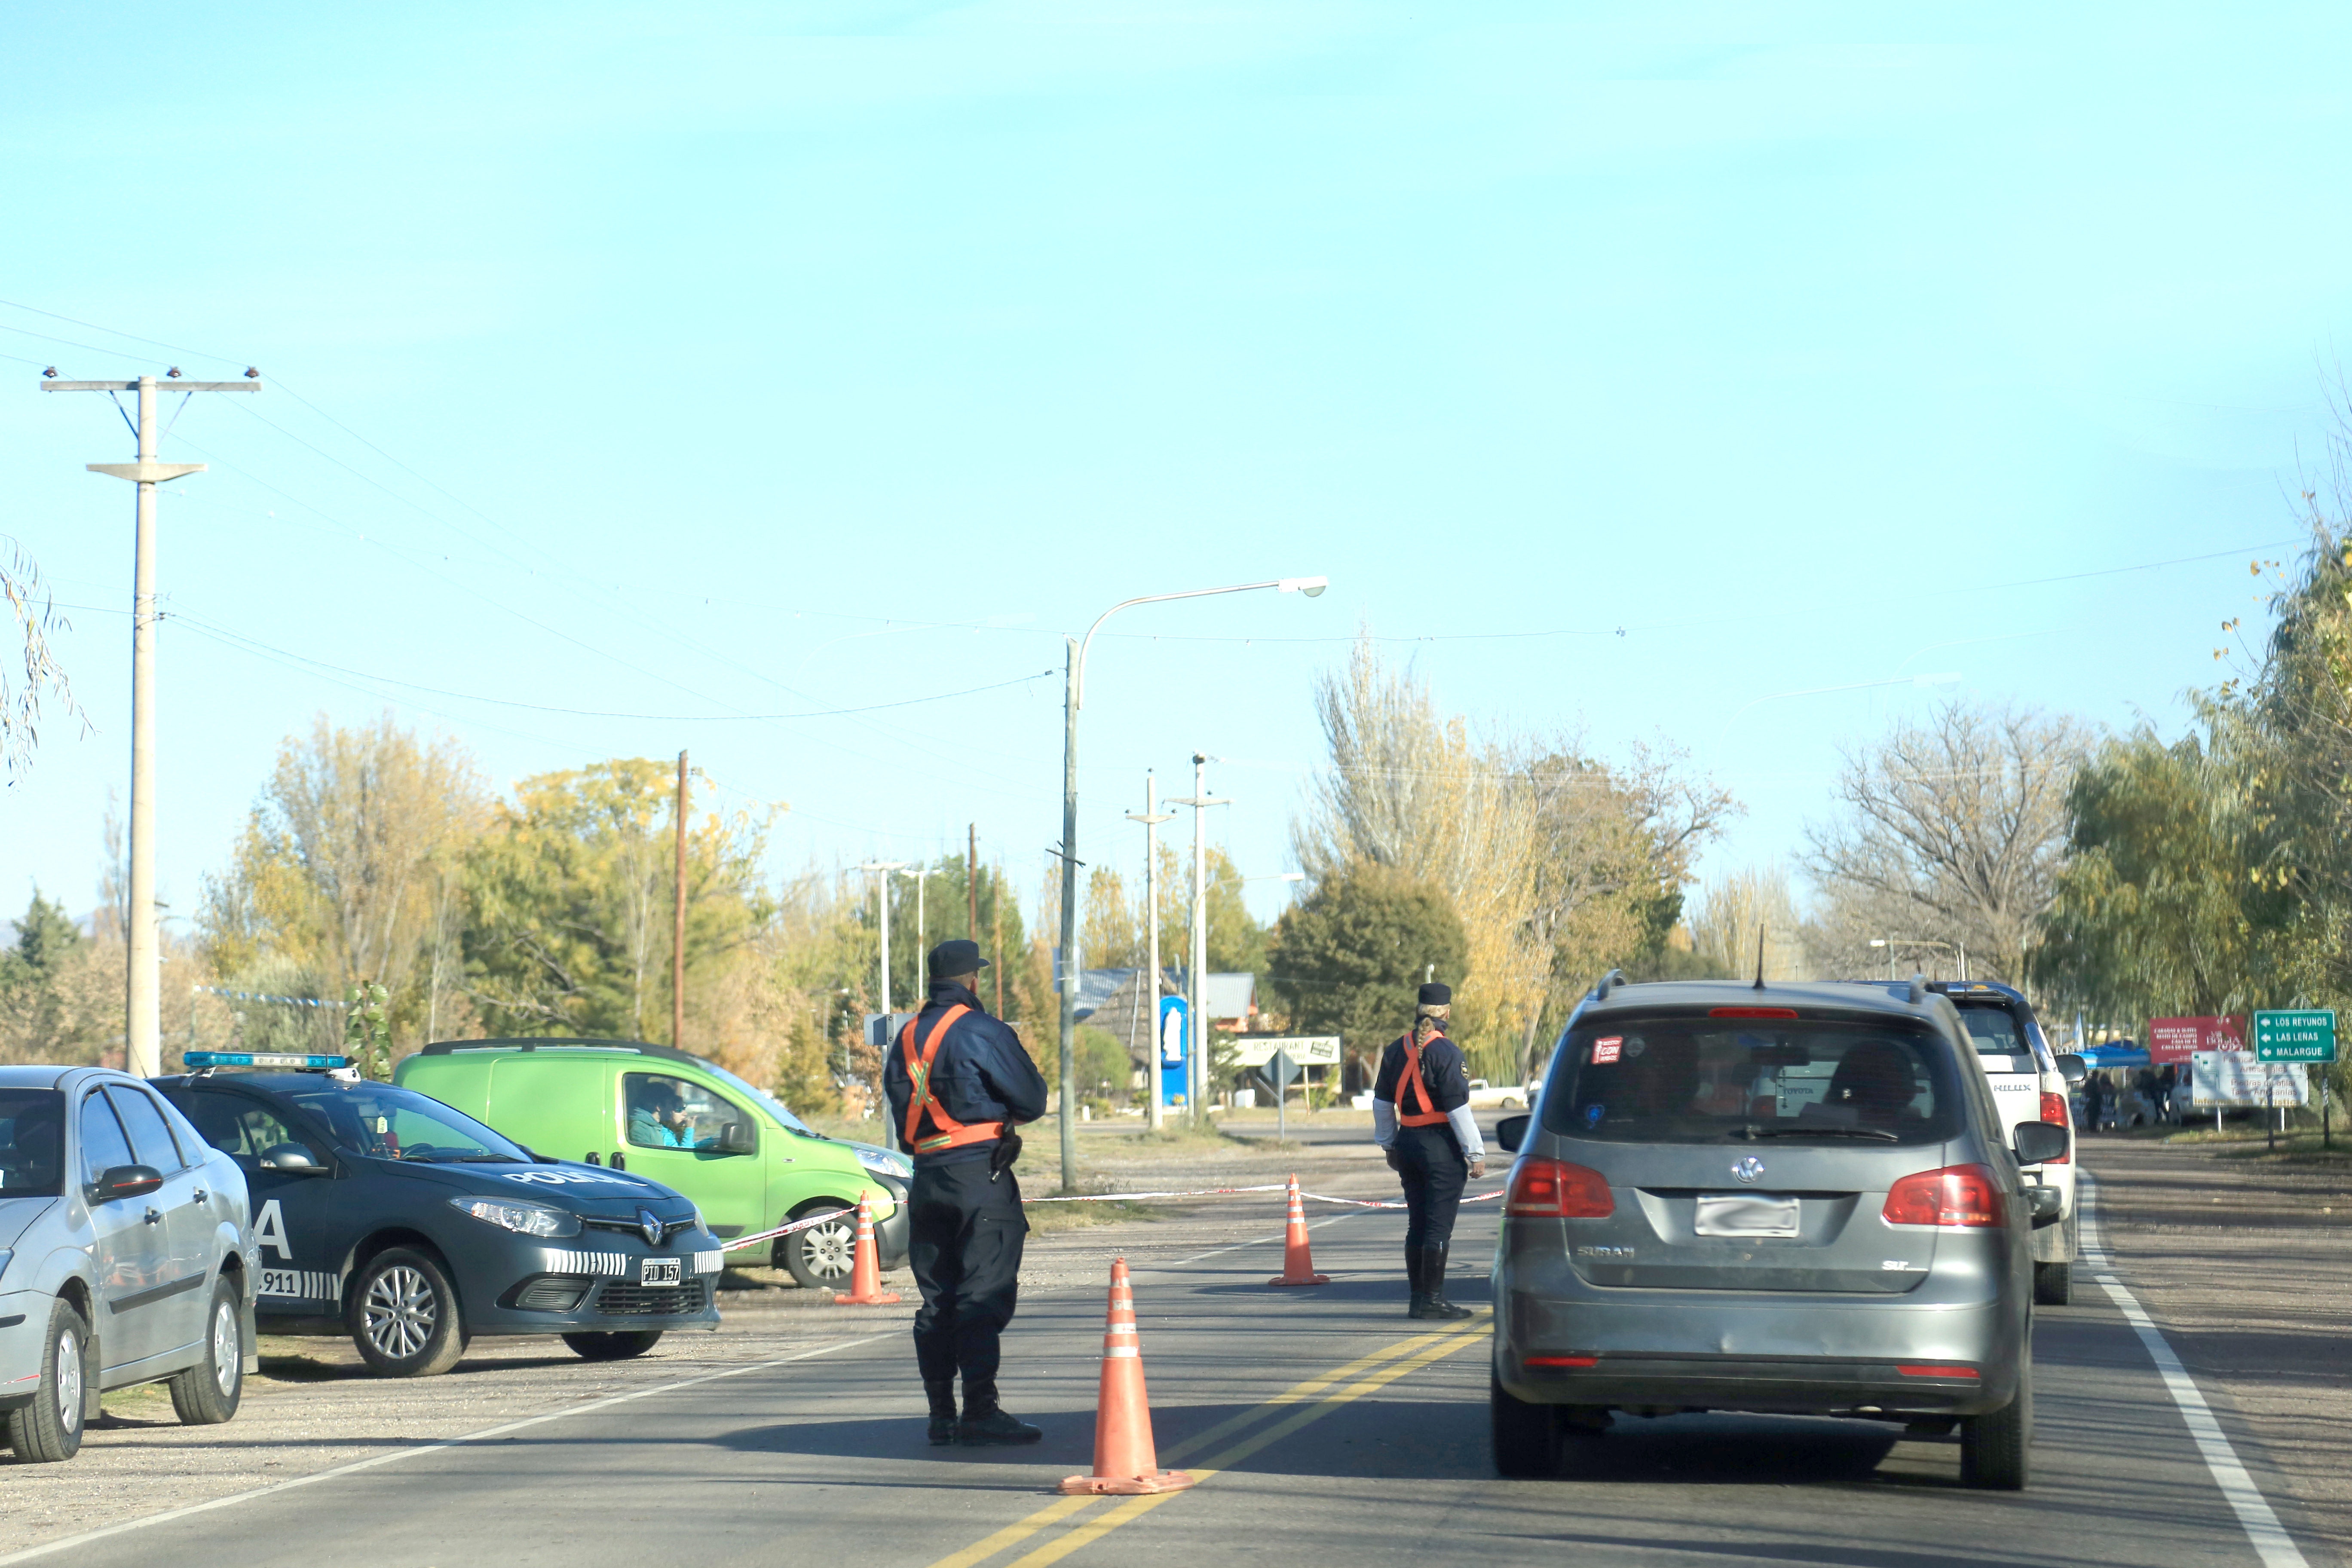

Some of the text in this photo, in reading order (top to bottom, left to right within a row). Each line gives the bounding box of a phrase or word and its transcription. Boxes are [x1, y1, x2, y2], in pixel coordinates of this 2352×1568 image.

[2275, 1017, 2327, 1027] LOS REYUNOS
[2276, 1032, 2291, 1041] LAS
[1254, 1040, 1305, 1051] RESTAURANT
[1602, 1046, 1620, 1055] CON
[2240, 1065, 2288, 1073] Artesaales
[1577, 1246, 1635, 1257] SURAN
[643, 1265, 679, 1281] PID 157
